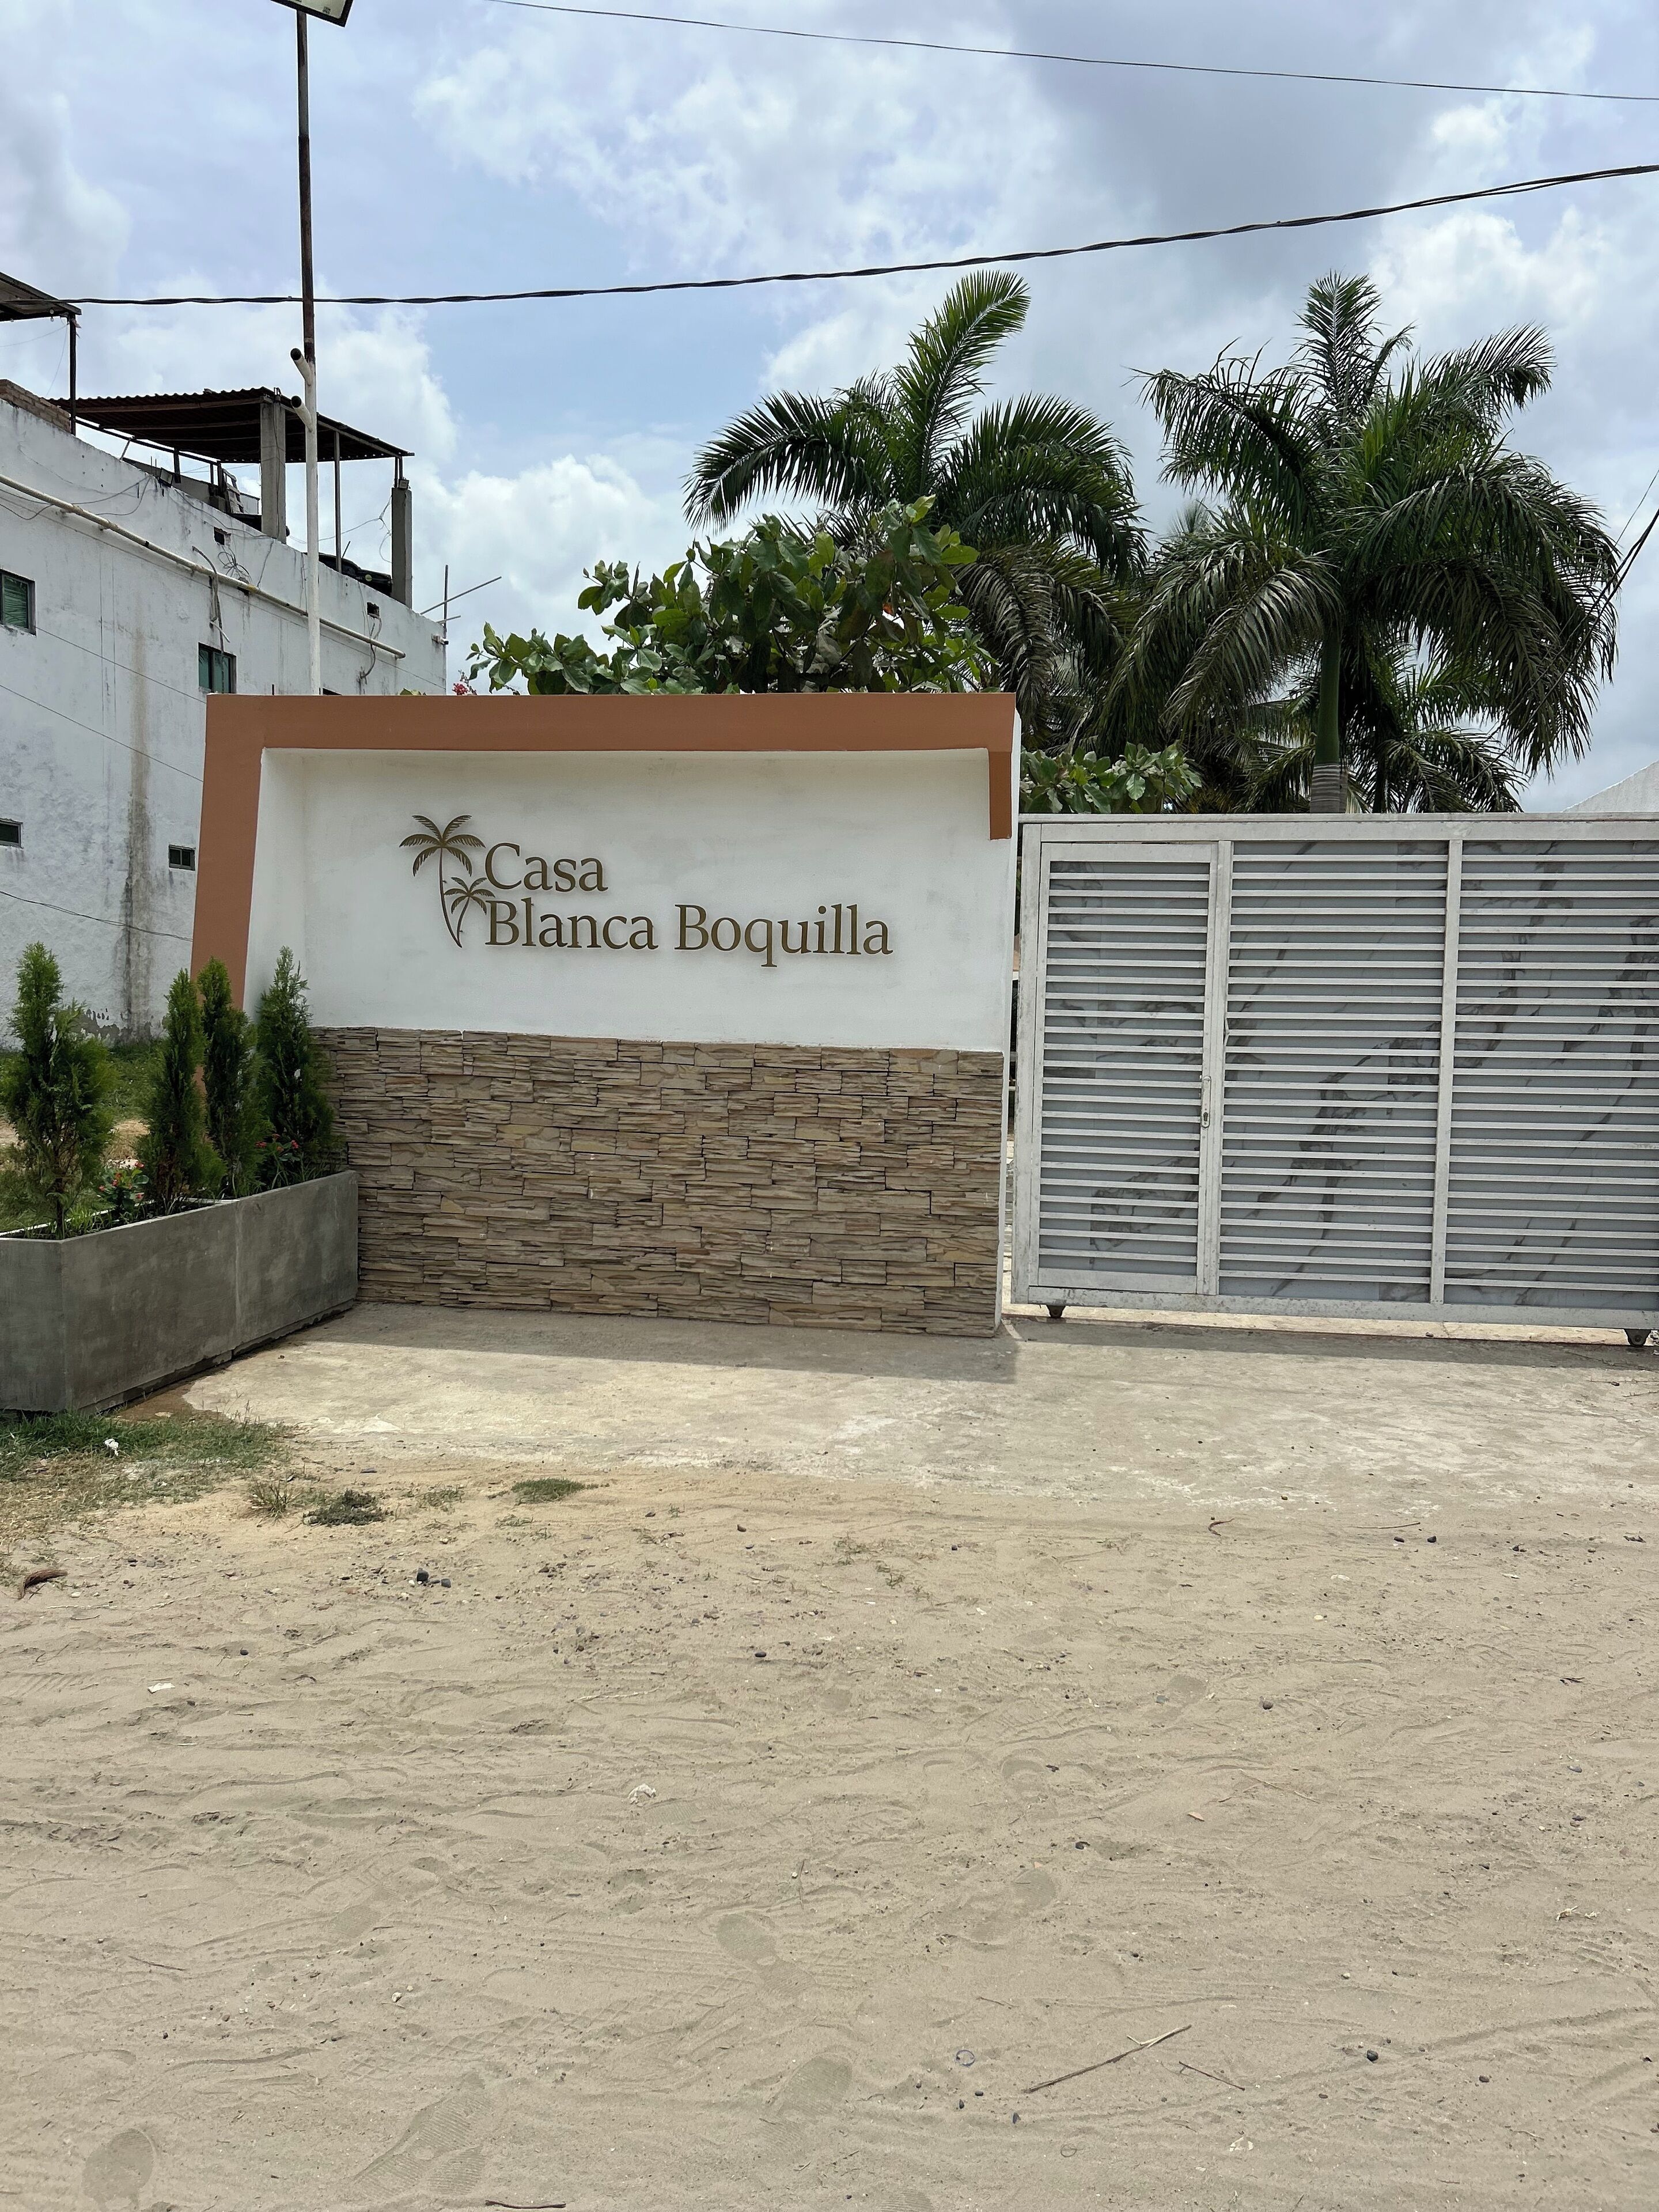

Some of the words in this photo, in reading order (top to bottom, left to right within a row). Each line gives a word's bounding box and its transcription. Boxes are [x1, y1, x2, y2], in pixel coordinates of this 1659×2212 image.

[484, 842, 608, 892] Casa
[484, 897, 658, 950] Blanca
[674, 904, 893, 968] Boquilla
